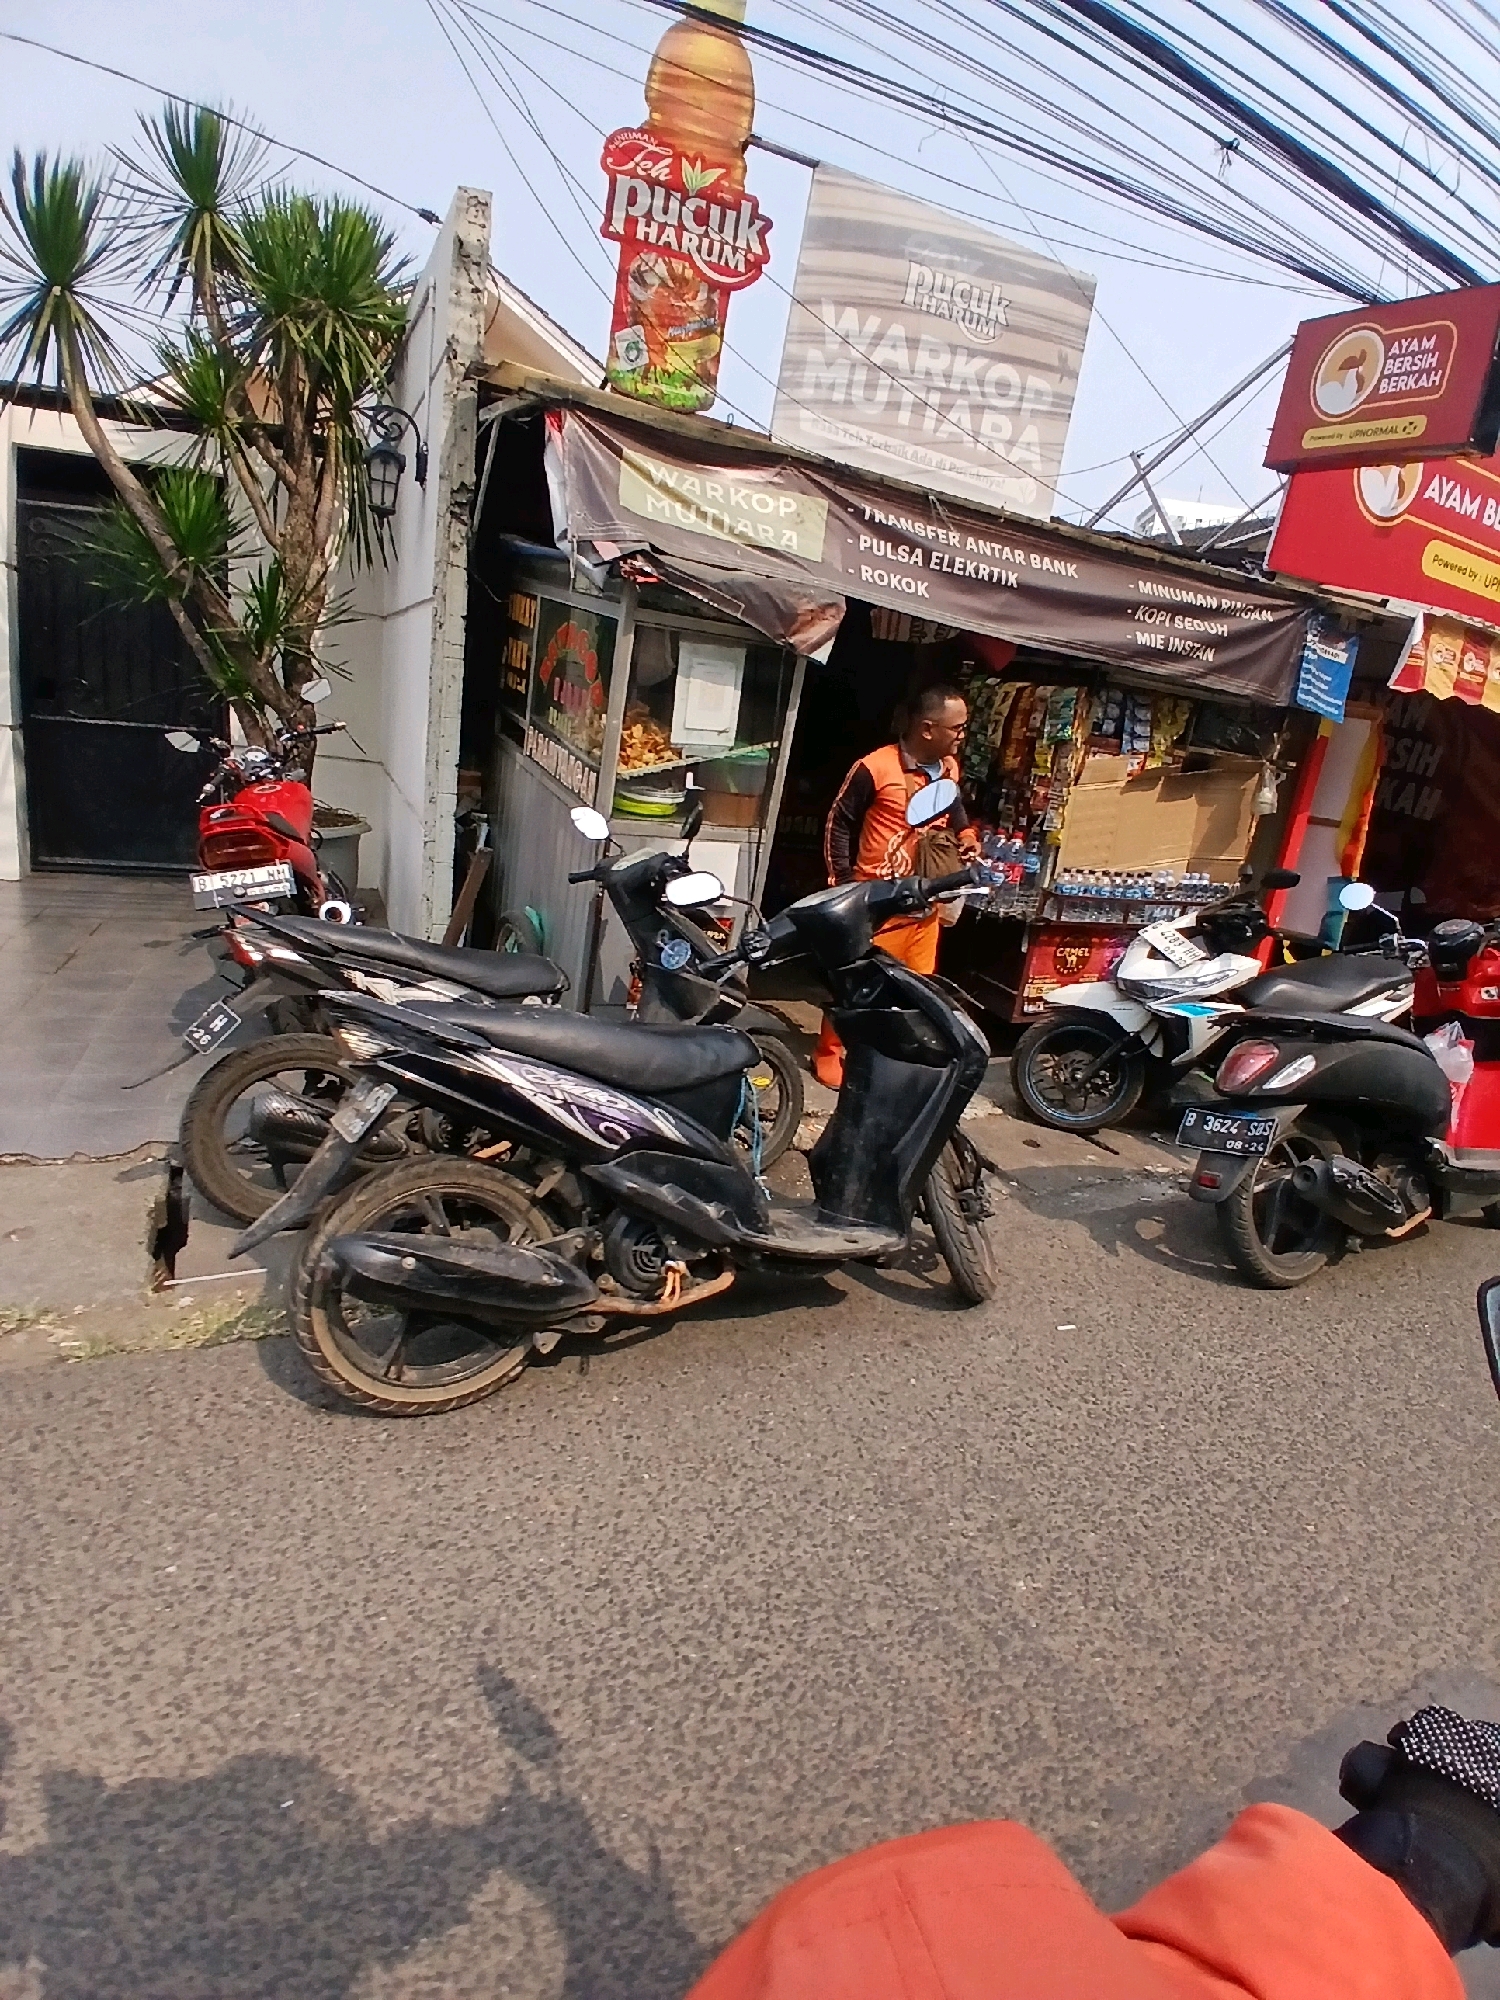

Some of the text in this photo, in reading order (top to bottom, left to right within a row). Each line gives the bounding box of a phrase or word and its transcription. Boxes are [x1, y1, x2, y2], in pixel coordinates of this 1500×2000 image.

[606, 140, 673, 181] Teh
[636, 217, 750, 274] HARUM
[920, 296, 998, 341] HARUM
[820, 298, 1054, 417] WARKOP
[1384, 351, 1439, 375] BERSIH
[1388, 334, 1437, 356] AYAM
[1379, 369, 1443, 395] BERKAH
[803, 349, 1043, 471] MUTIARA
[1349, 425, 1399, 440] UPNORMAL
[645, 461, 798, 517] WARKOP
[1423, 473, 1483, 520] AYAM
[646, 493, 799, 550] MUTIARA
[861, 503, 961, 549] TRANSFER
[965, 535, 1027, 566] ANTAR
[1029, 553, 1079, 579] BANK
[858, 534, 923, 567] PULSA
[929, 552, 1019, 589] ELEKRTIK
[1432, 553, 1468, 576] Powered
[860, 564, 930, 599] ROKOK
[1138, 580, 1218, 610] MINUMAN
[1220, 598, 1274, 622] RINGAN
[1134, 605, 1172, 628] KOPI
[1174, 615, 1228, 637] SEDUH
[1135, 631, 1165, 650] MIE
[1167, 636, 1216, 662] INSTAN
[197, 878, 207, 891] B
[1056, 947, 1090, 957] CAMEL
[1185, 1112, 1197, 1127] B
[1203, 1115, 1241, 1134] 3624
